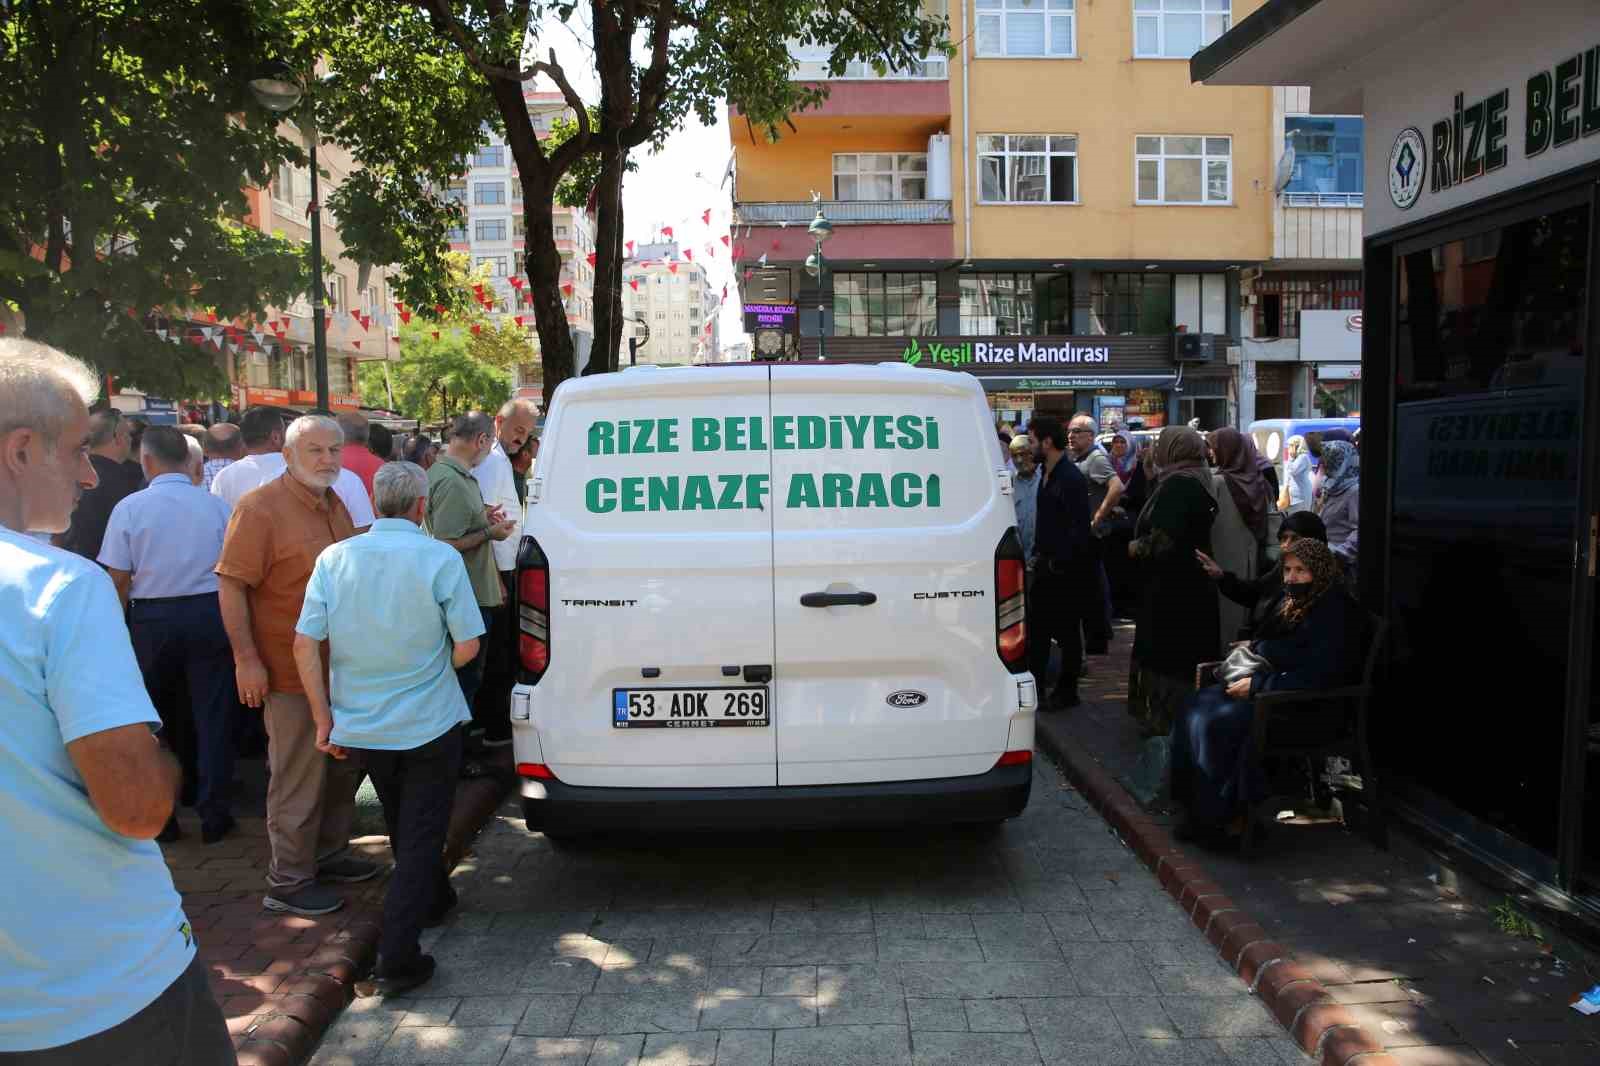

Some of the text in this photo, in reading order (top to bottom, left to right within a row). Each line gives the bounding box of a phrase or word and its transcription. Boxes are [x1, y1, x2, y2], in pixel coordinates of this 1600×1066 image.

[1432, 88, 1509, 194] RİZE
[928, 343, 1109, 366] Yeşil Rize Mandırası
[588, 415, 940, 455] RİZE BELEDİYESİ
[787, 472, 941, 508] ARACI
[914, 590, 985, 600] CUSTOM
[616, 707, 627, 715] TR
[629, 692, 764, 717] 53 ADK 269
[895, 693, 921, 705] Ford
